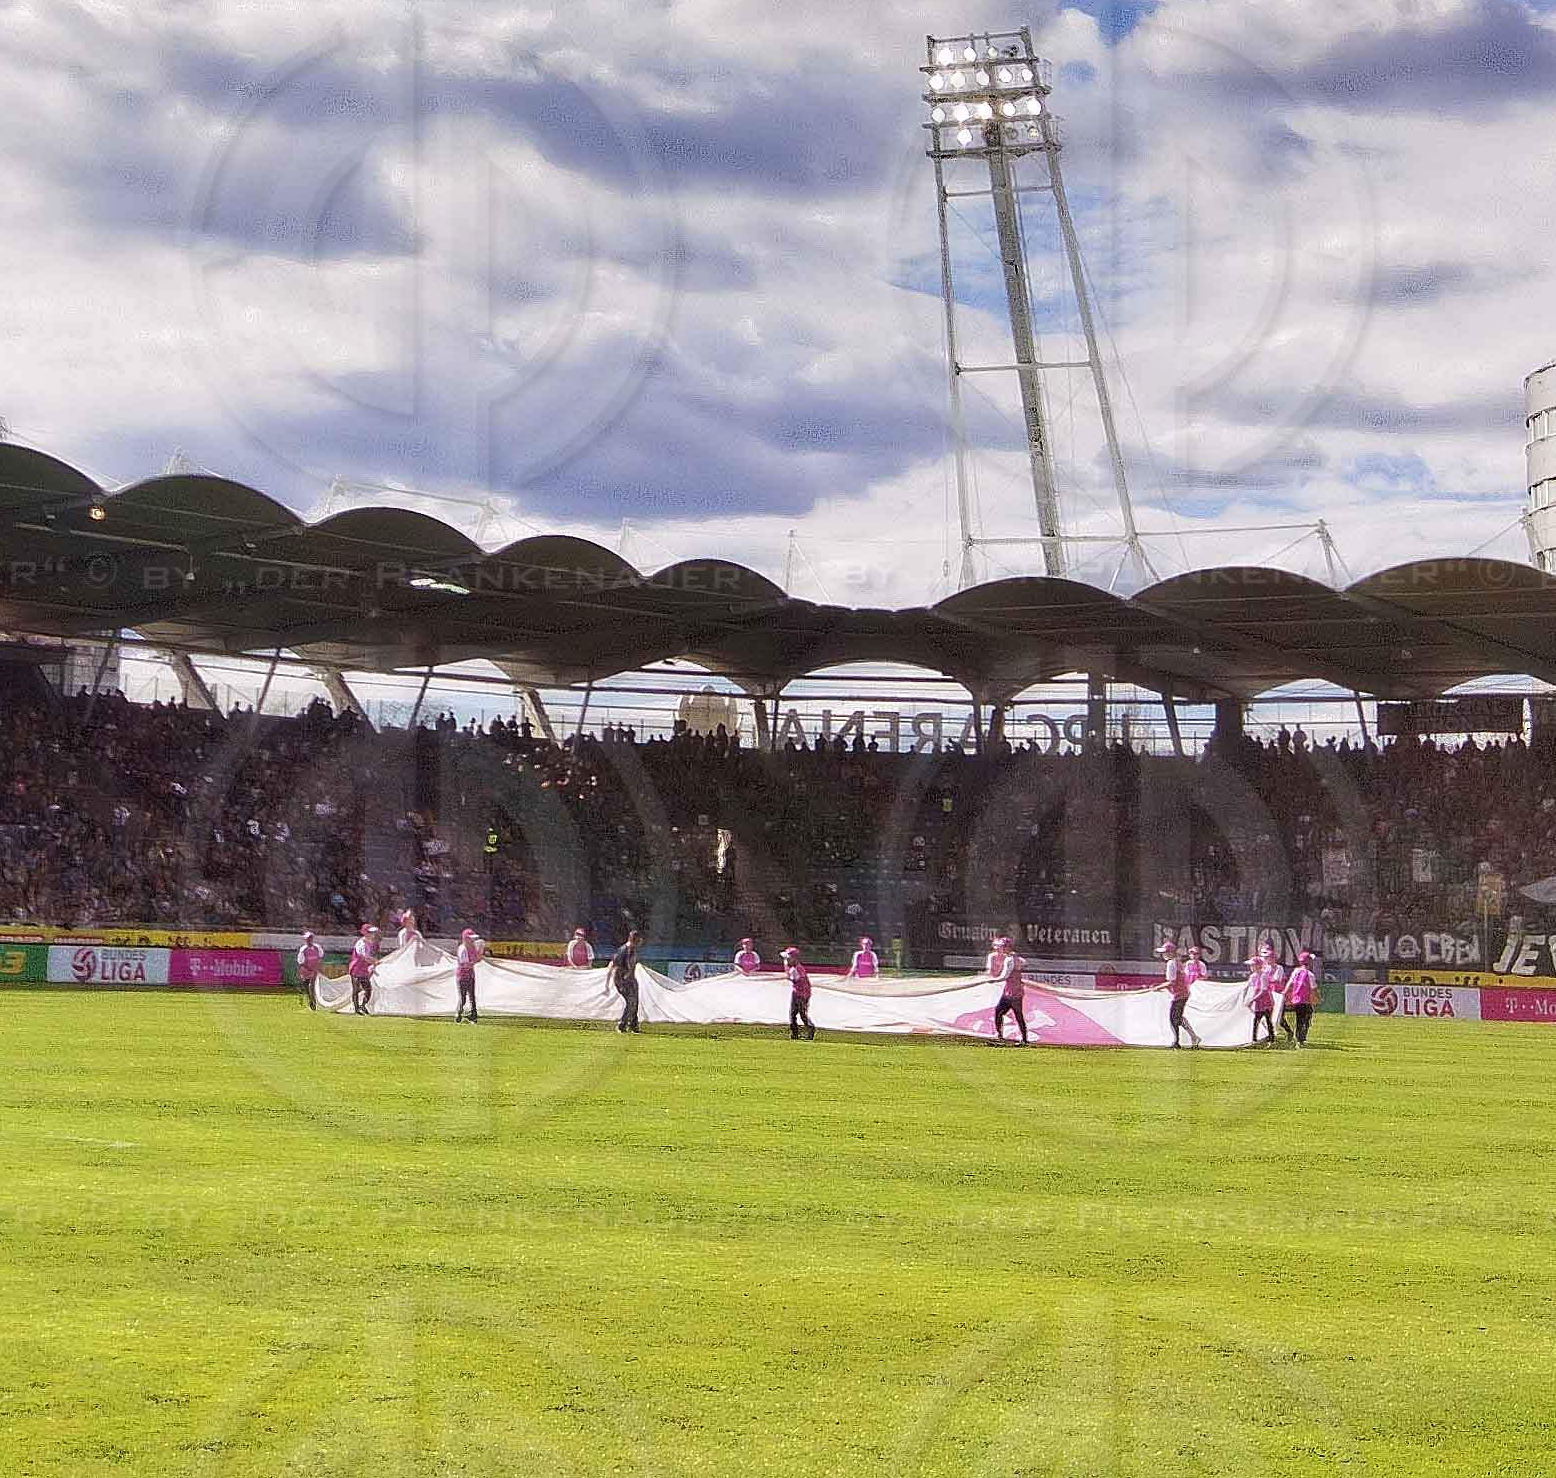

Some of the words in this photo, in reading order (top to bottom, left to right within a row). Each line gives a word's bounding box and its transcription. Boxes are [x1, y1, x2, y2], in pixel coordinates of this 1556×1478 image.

[1026, 924, 1112, 945] Veteranen
[99, 961, 146, 982] LIGA
[1403, 986, 1453, 998] BUNDES
[1403, 999, 1455, 1018] LIGA
